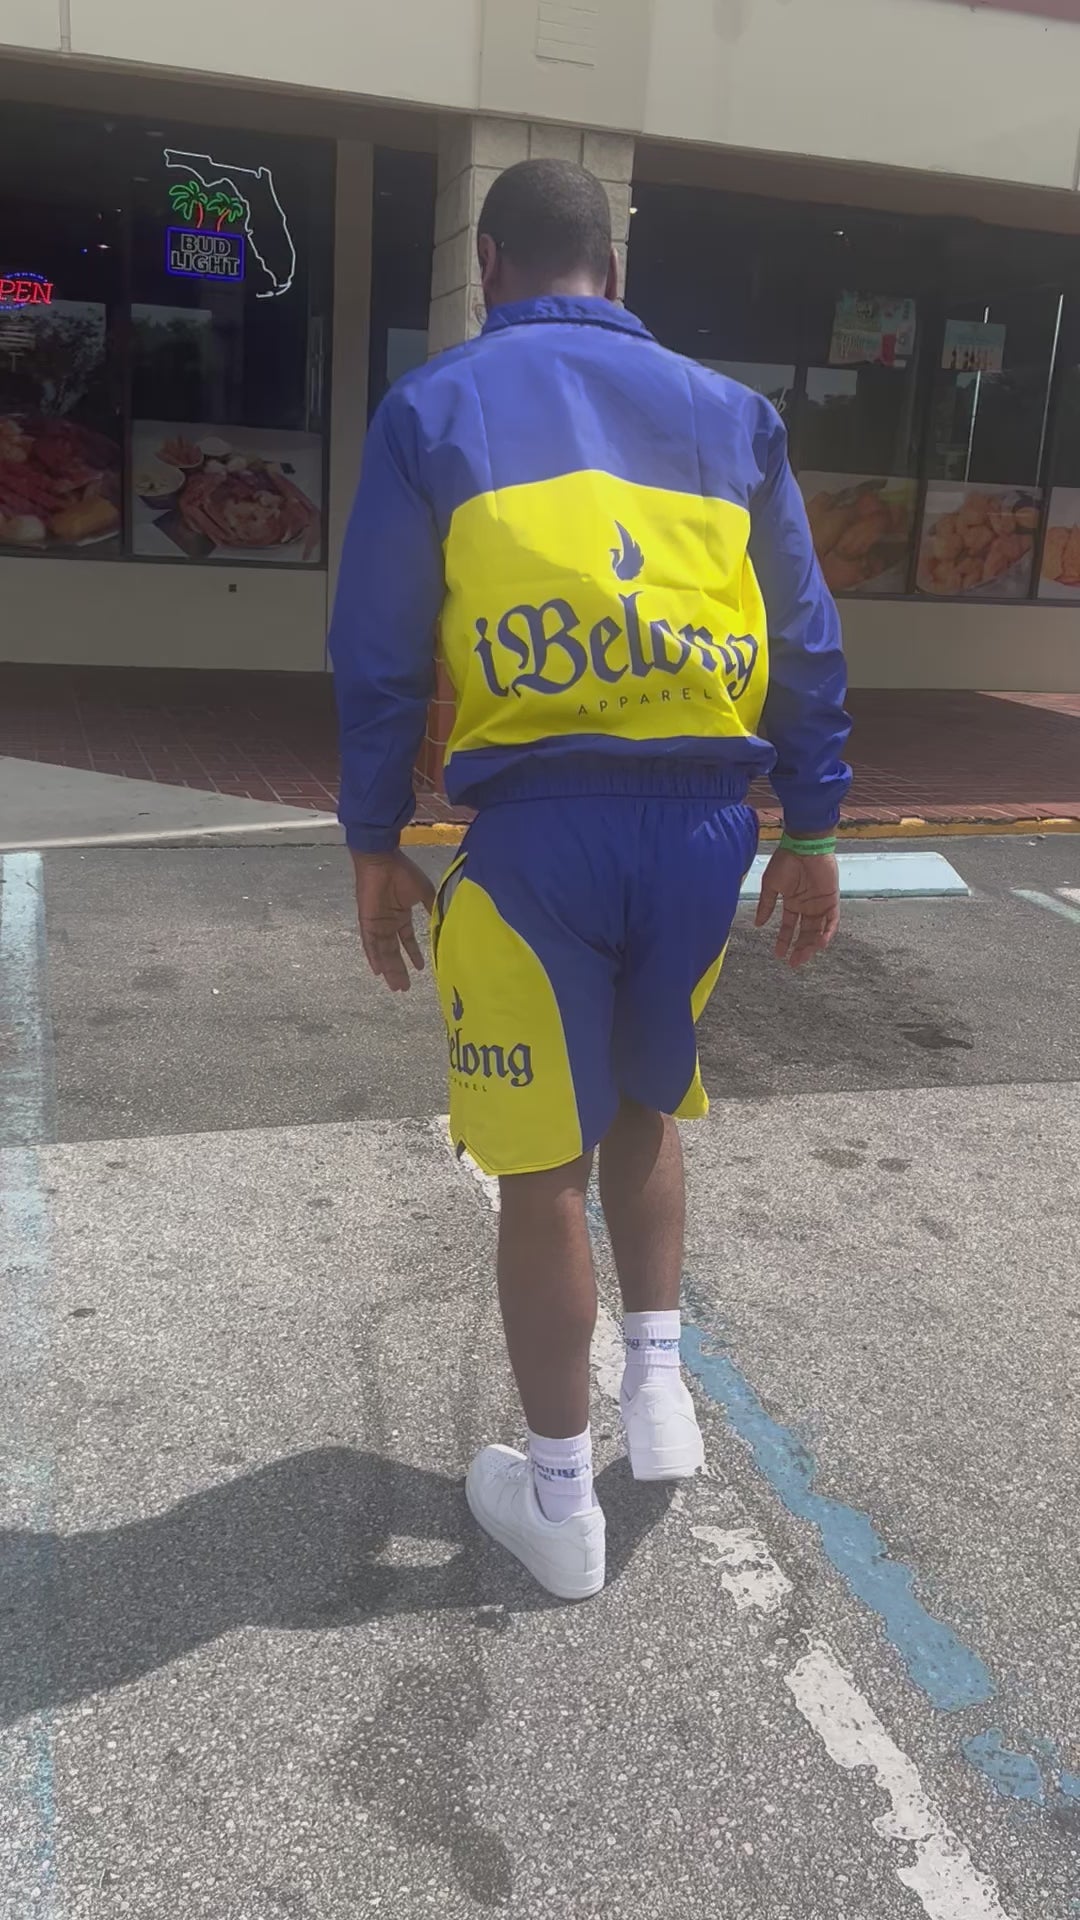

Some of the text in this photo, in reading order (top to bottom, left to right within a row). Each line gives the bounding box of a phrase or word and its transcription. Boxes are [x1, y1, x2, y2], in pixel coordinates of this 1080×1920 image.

[181, 233, 231, 256] BUD
[171, 250, 240, 276] LIGHT
[0, 278, 54, 305] PEN
[474, 591, 759, 701] iBelong
[577, 688, 713, 716] APPAREL
[447, 1028, 534, 1087] elong
